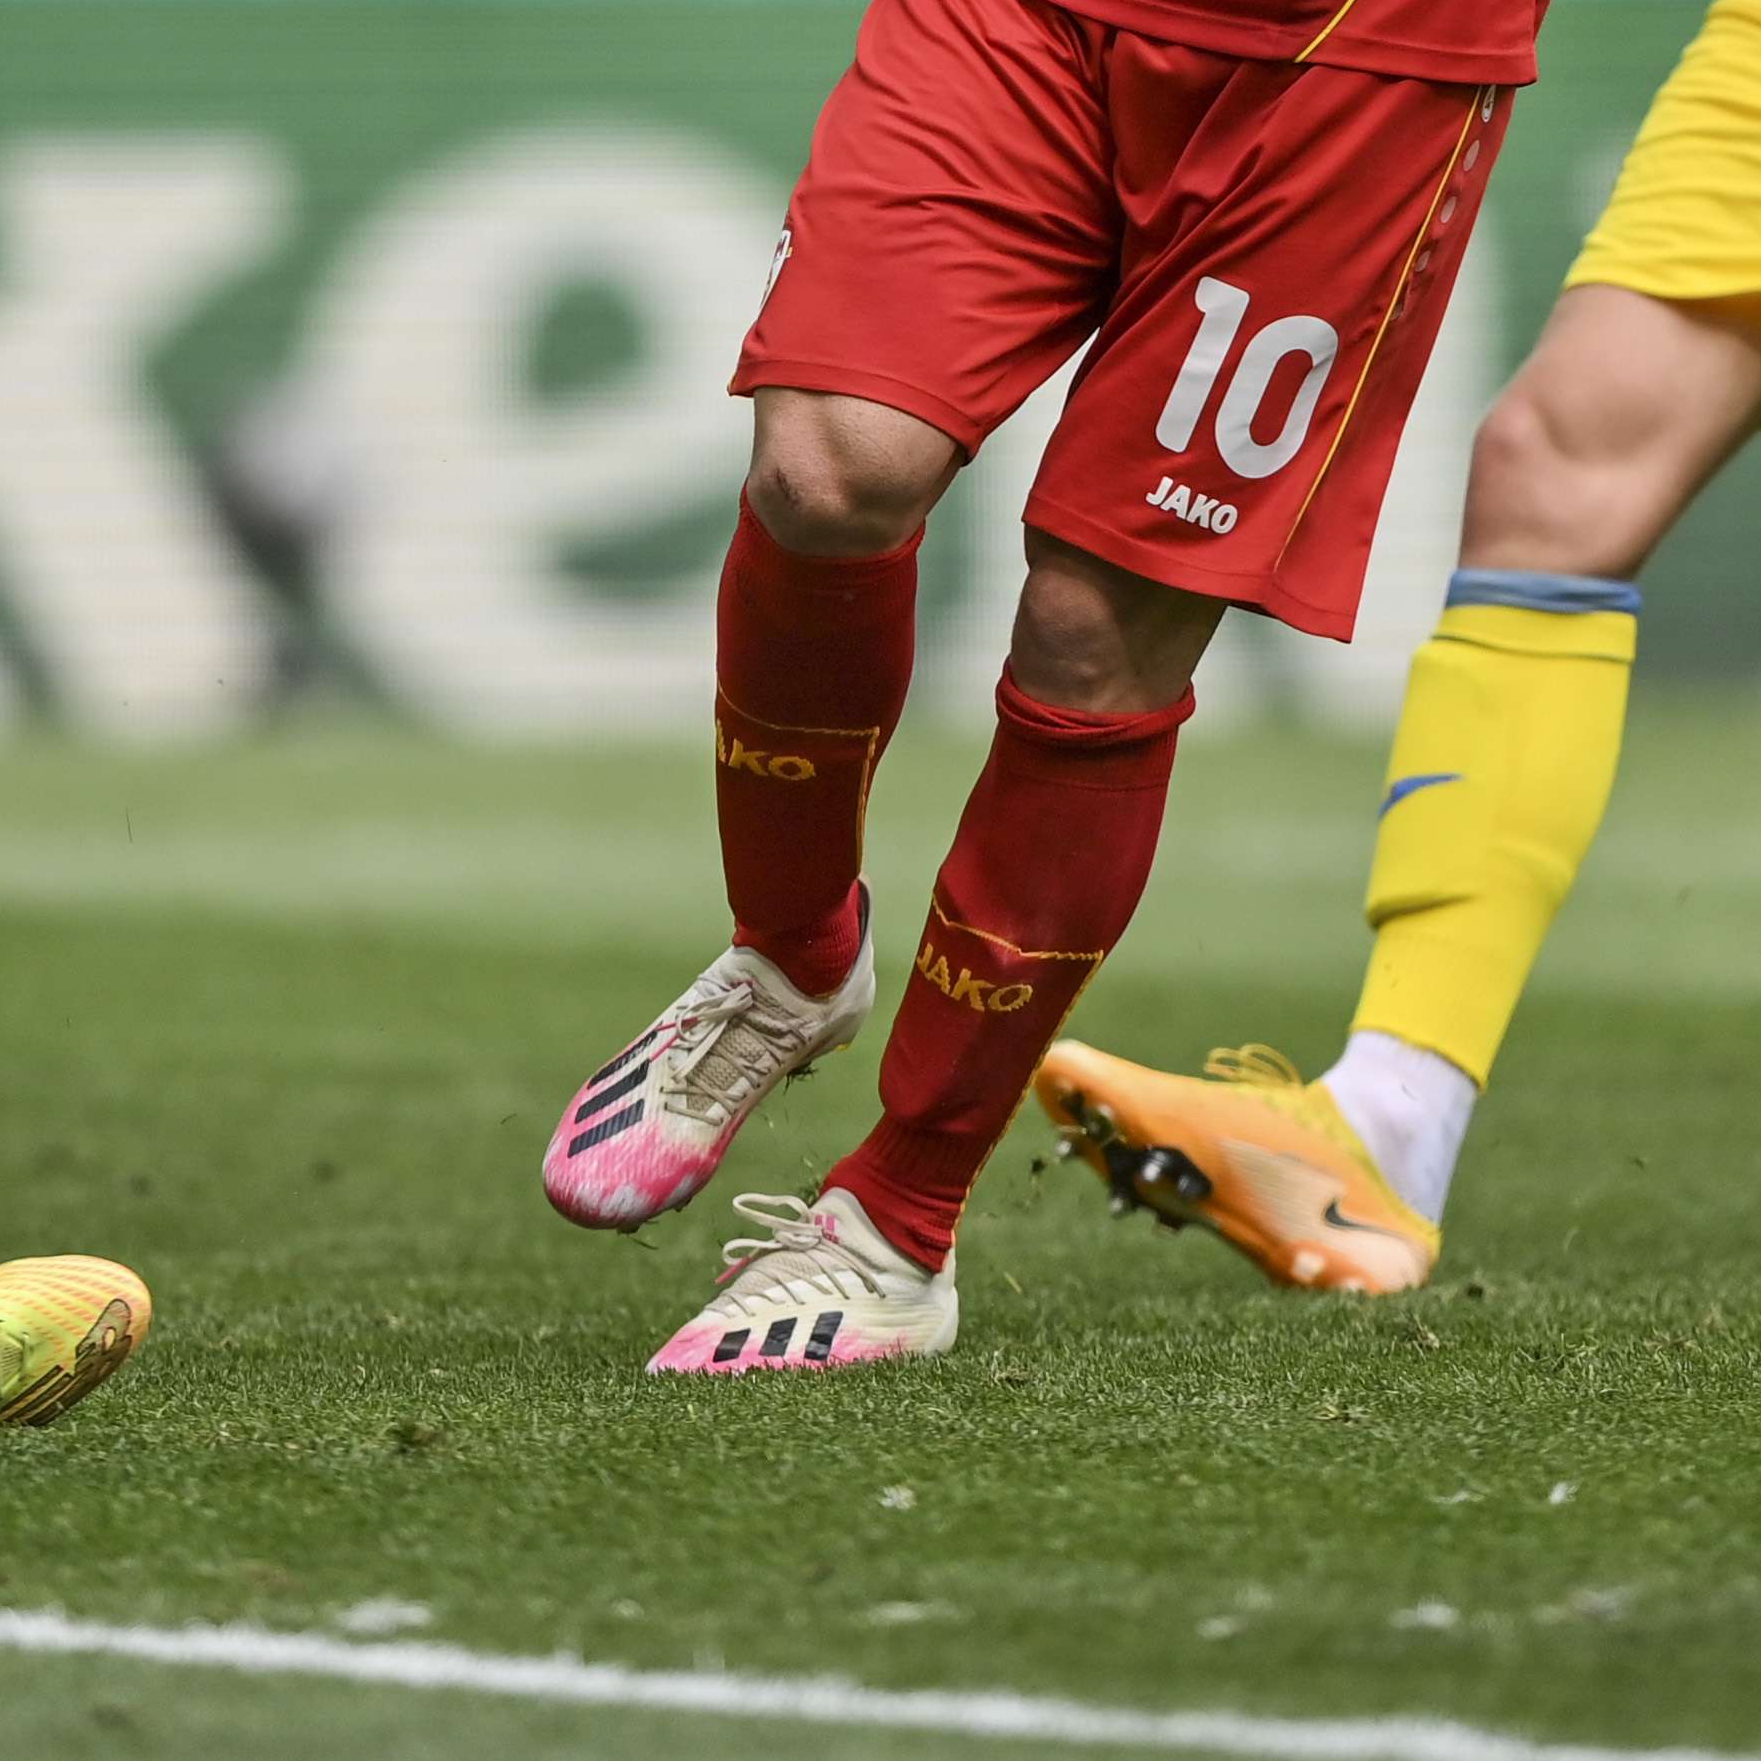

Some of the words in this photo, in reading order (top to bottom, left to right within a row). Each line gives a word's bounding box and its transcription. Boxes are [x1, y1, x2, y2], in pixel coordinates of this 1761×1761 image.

[1155, 276, 1339, 479] 10
[1146, 476, 1238, 534] JAKO
[917, 942, 1033, 1013] JAKO
